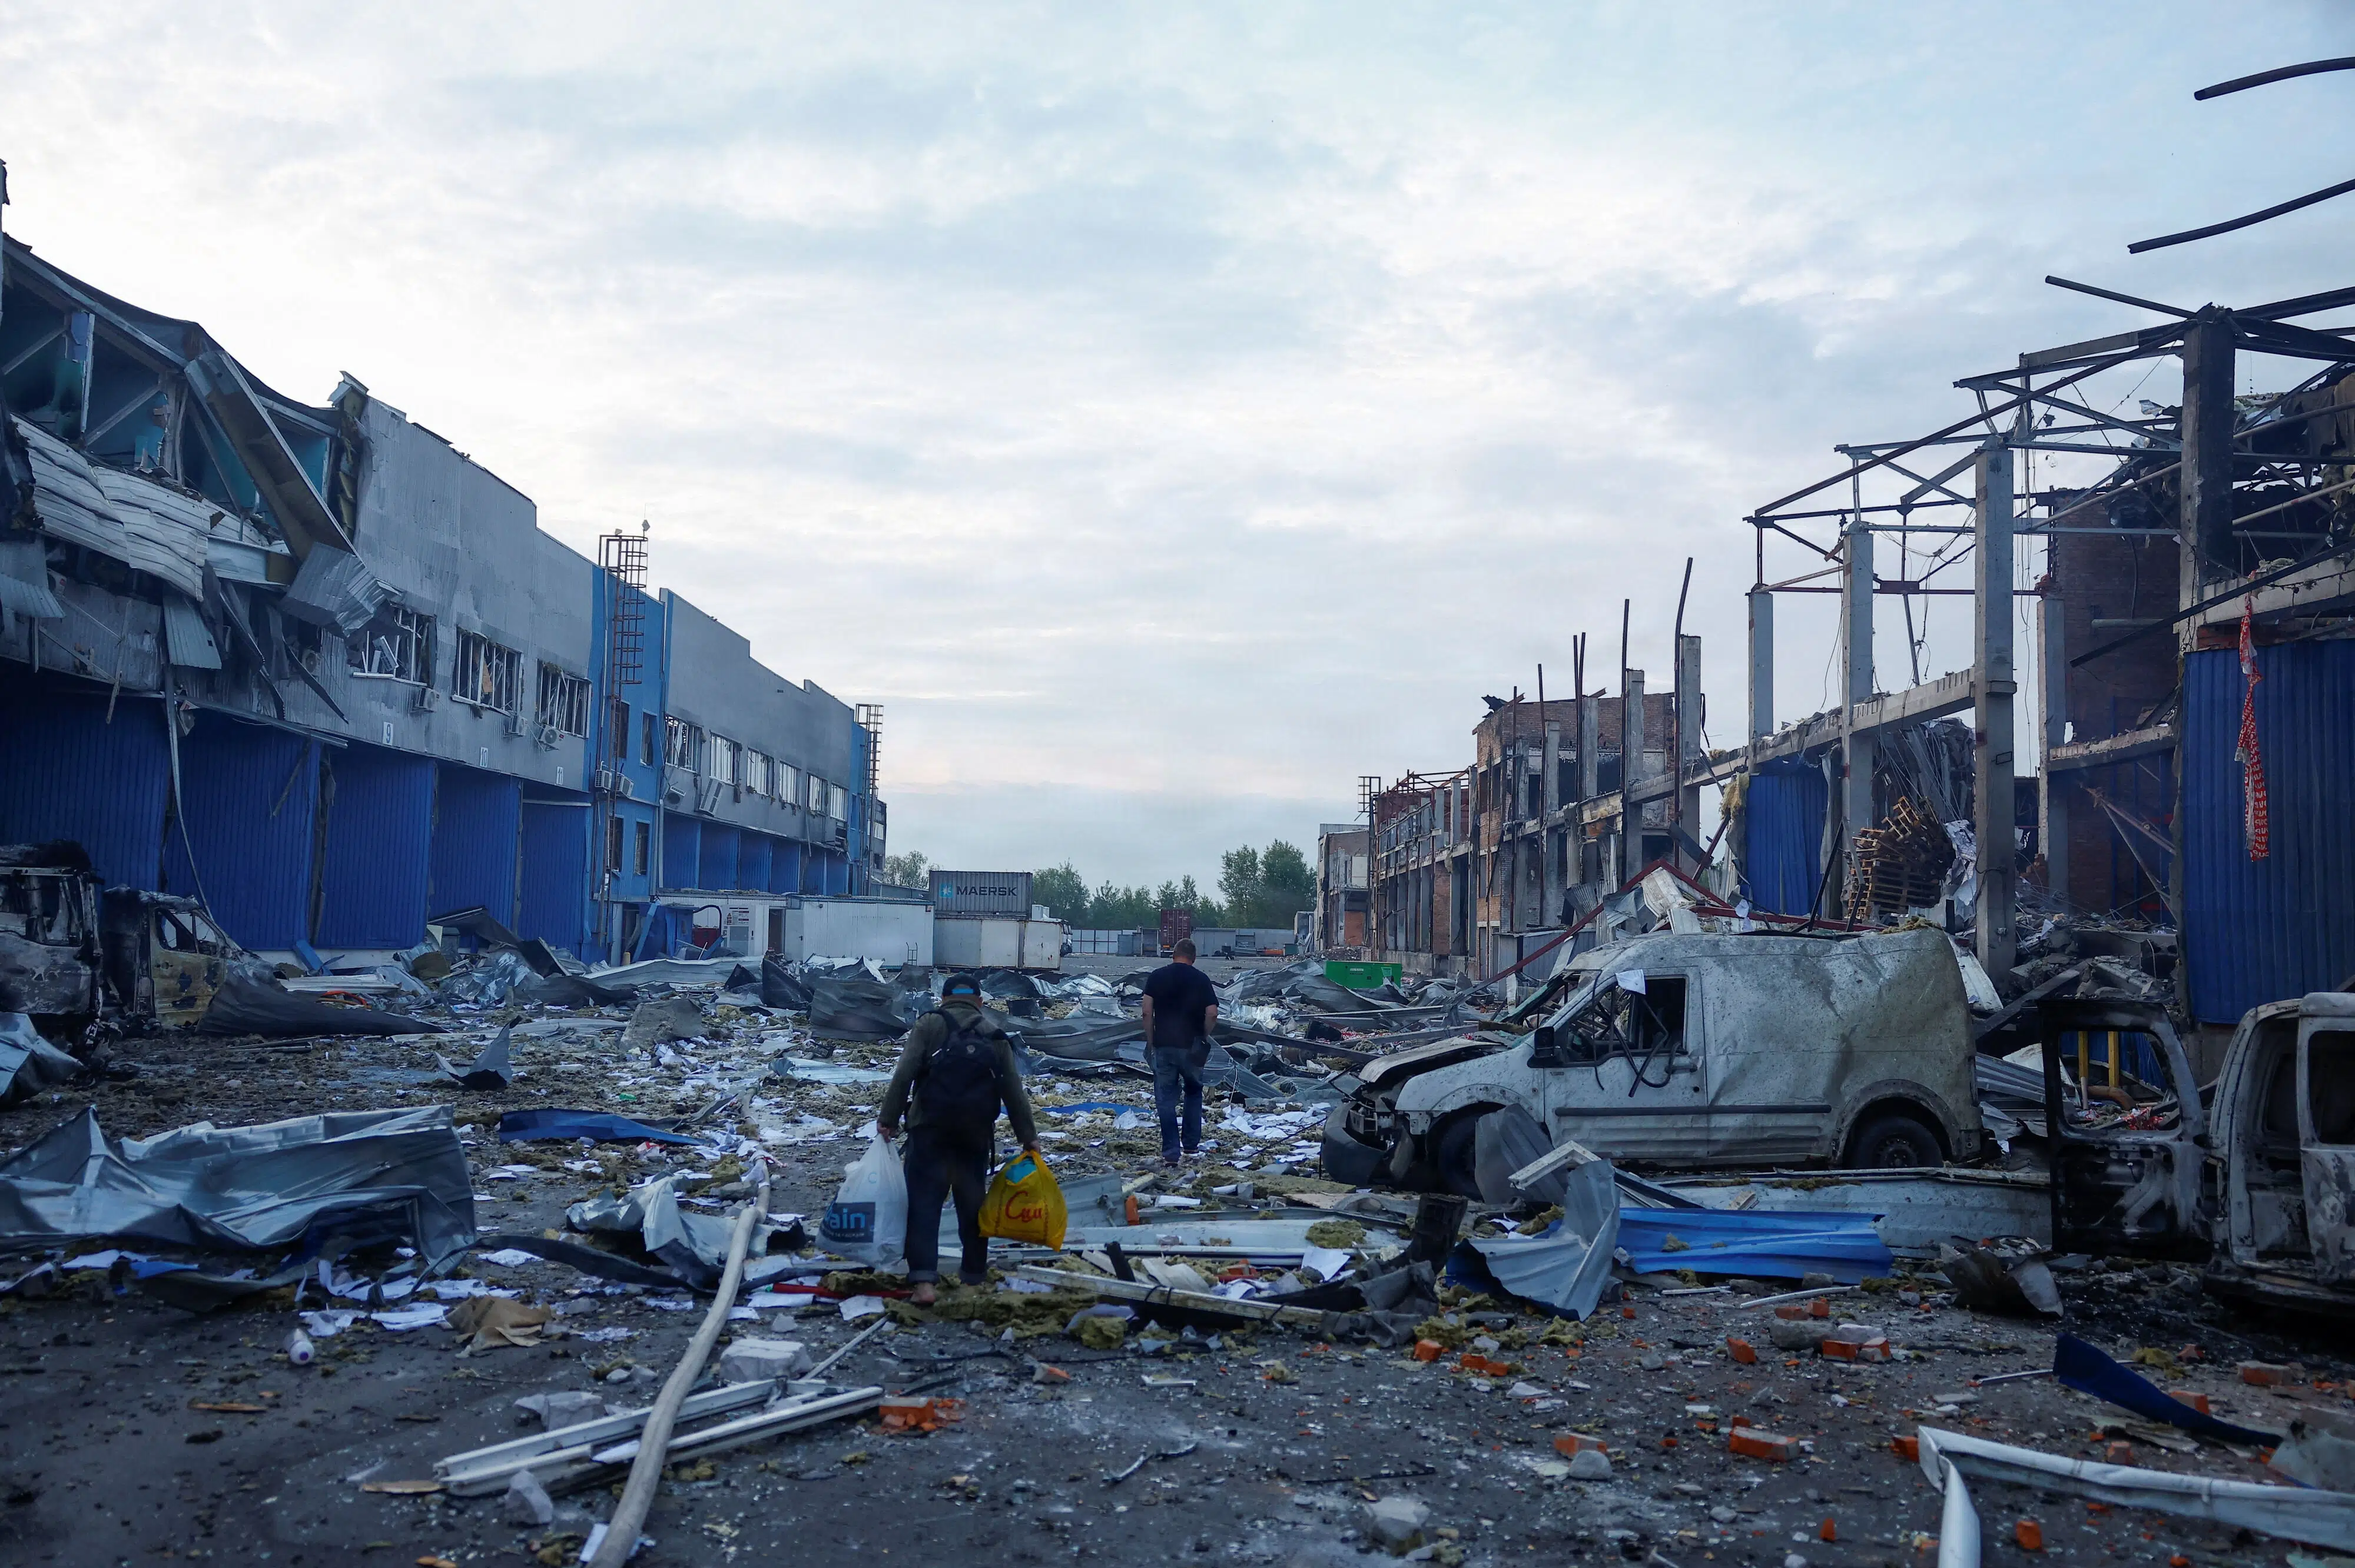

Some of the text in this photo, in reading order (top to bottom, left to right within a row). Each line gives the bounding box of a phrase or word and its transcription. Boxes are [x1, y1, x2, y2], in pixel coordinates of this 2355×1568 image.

[386, 724, 391, 743] 9
[482, 748, 487, 766] 10
[558, 768, 562, 783] 11
[957, 885, 1017, 896] MAERSK
